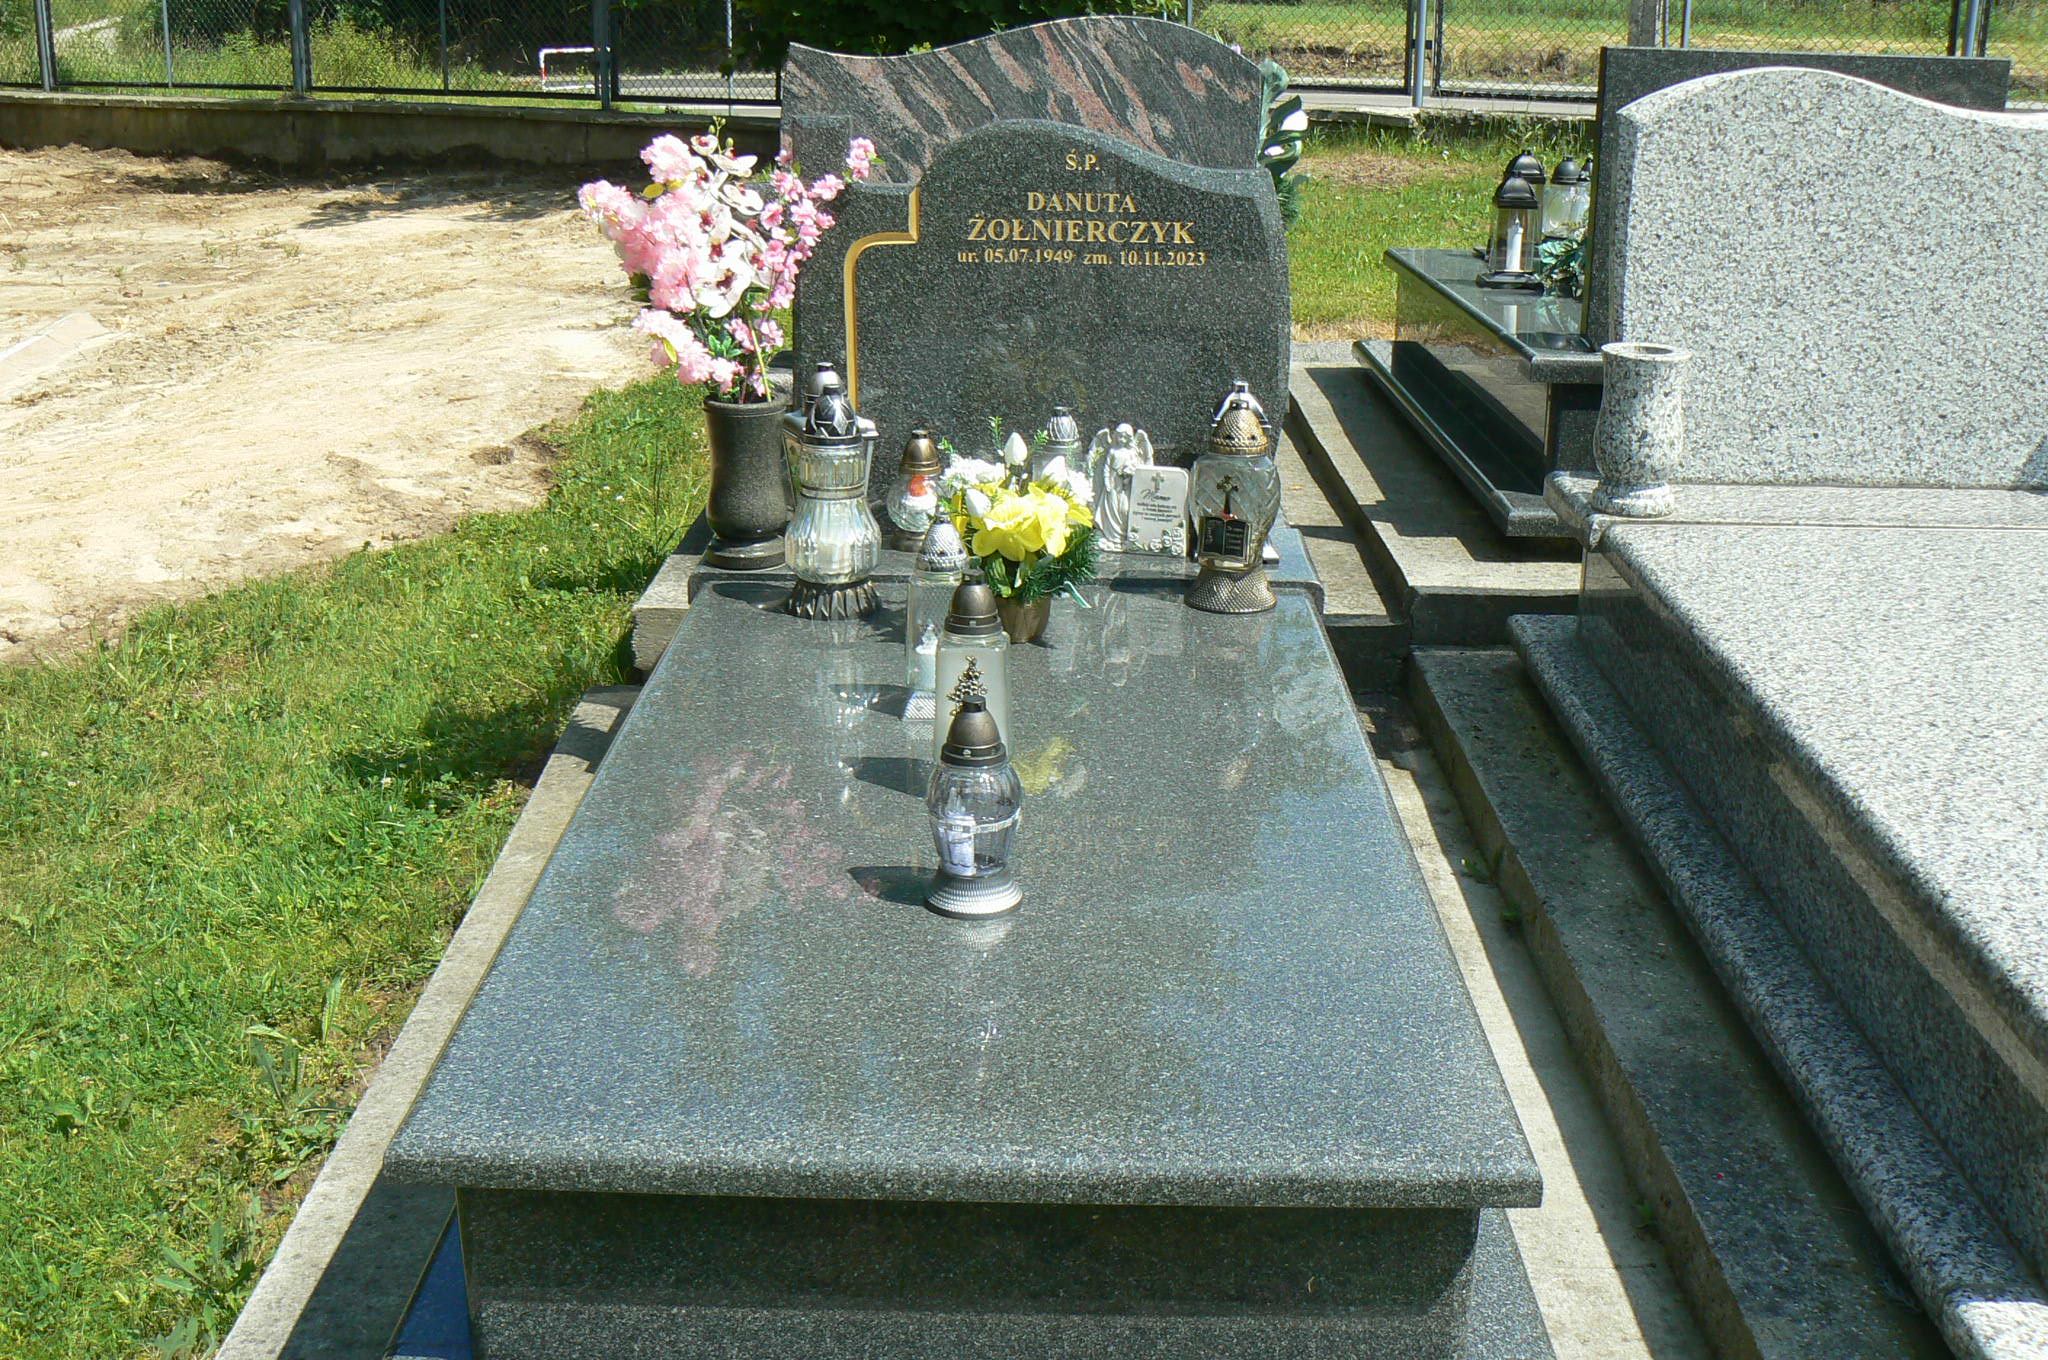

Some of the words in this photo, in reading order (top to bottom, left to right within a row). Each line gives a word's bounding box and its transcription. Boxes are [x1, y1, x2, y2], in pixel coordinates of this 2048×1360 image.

[1065, 148, 1101, 171] Ś.P.
[1026, 191, 1137, 213] DANUTA
[967, 213, 1196, 244] ŻOŁNIERCZYK
[957, 251, 979, 263] ur.
[984, 248, 1073, 264] 05.07.1949
[1082, 252, 1113, 265] zm.
[1119, 250, 1207, 266] 10.11.2023
